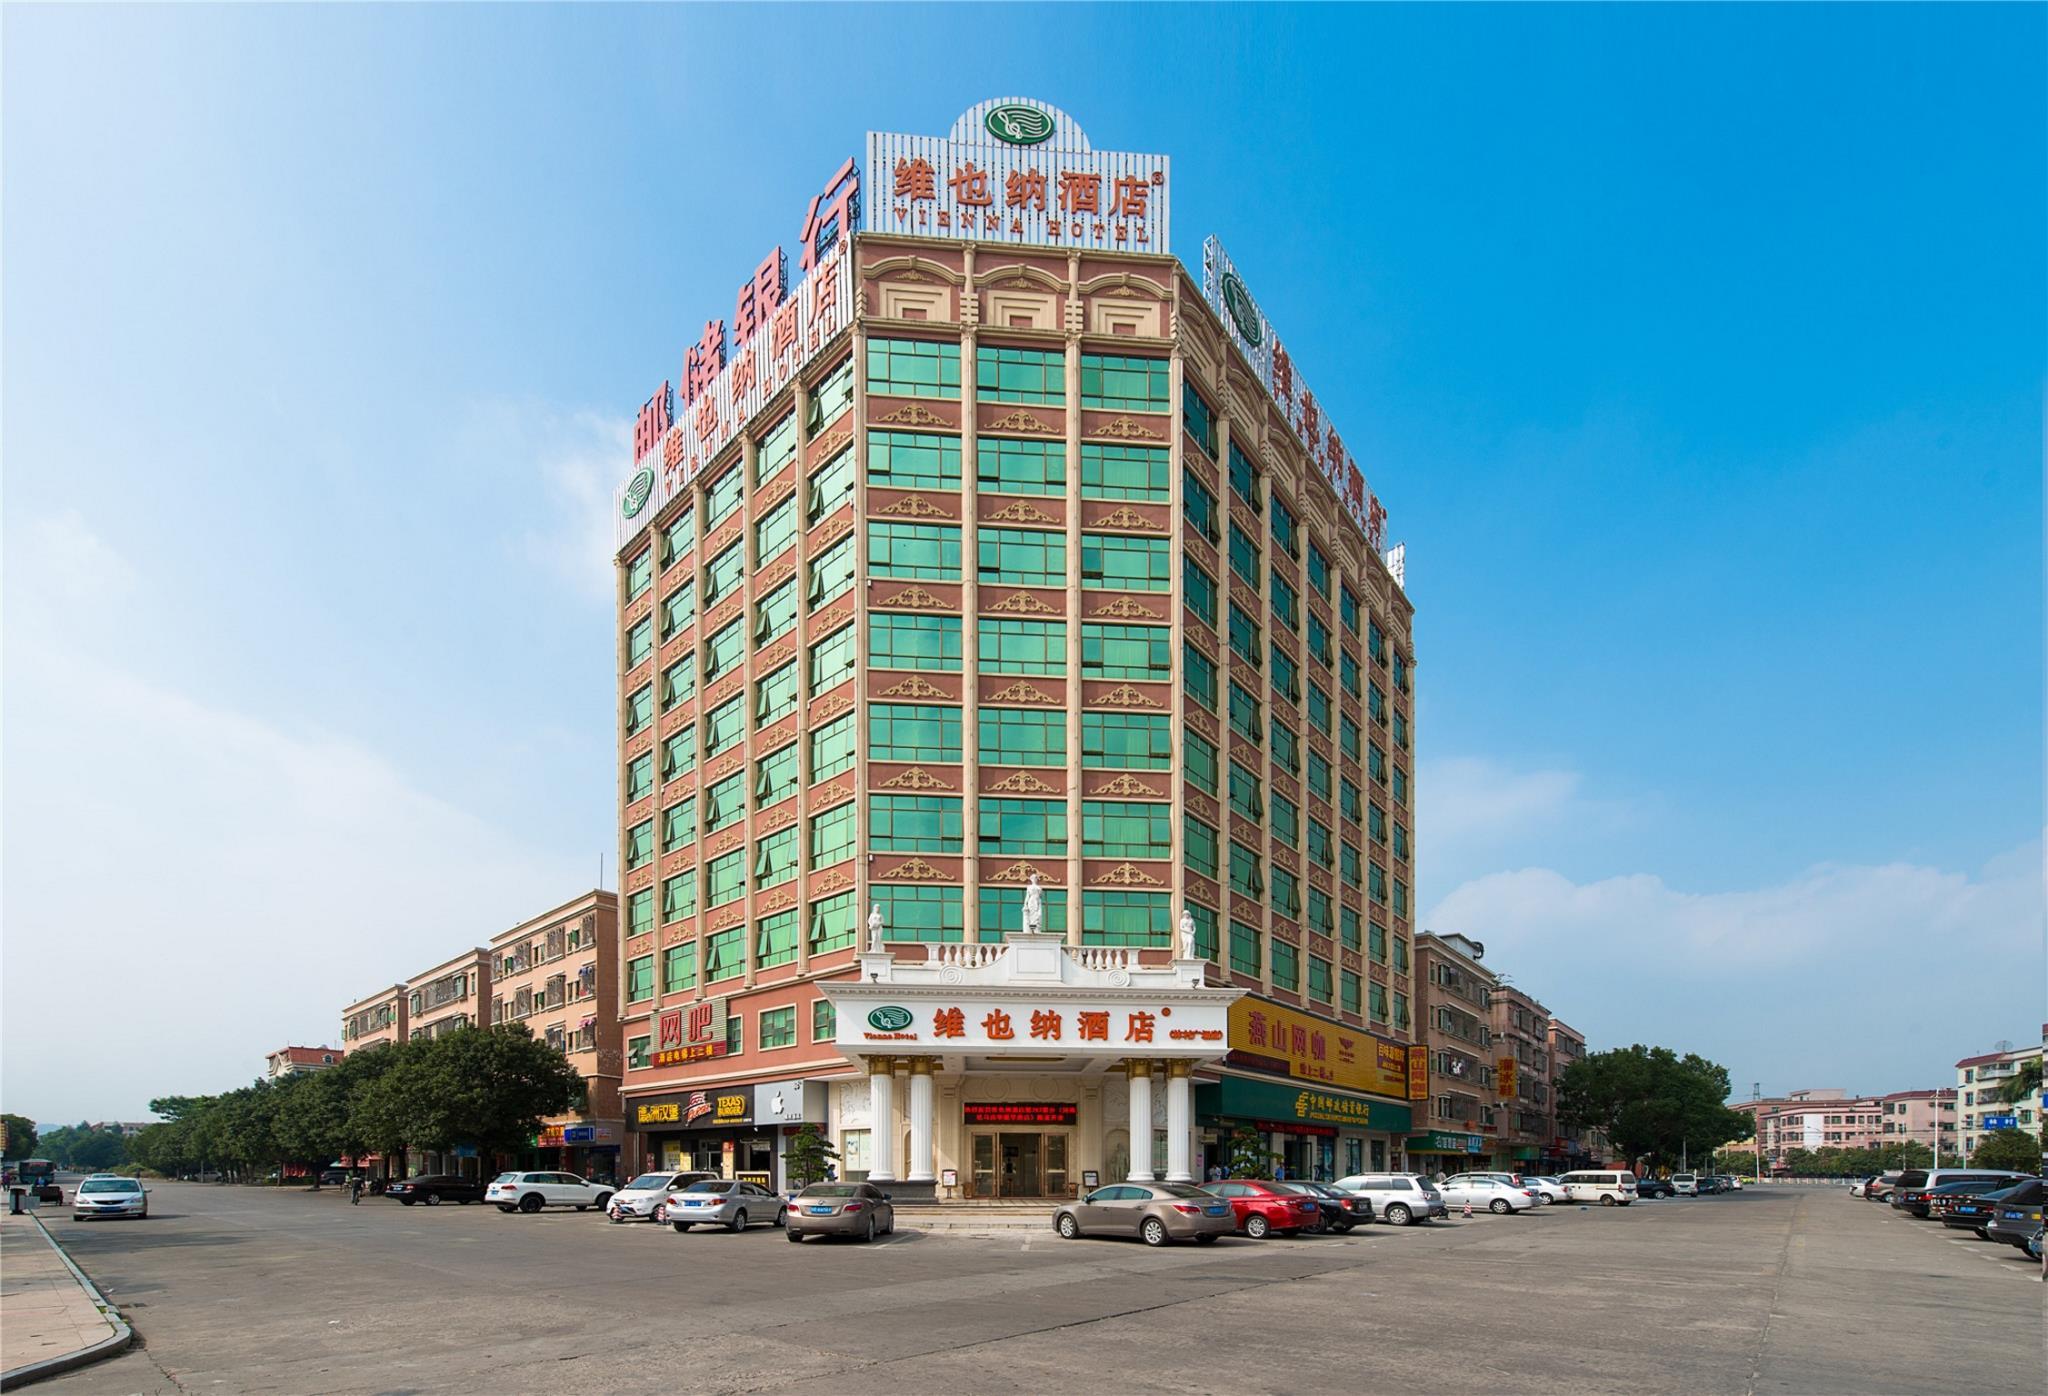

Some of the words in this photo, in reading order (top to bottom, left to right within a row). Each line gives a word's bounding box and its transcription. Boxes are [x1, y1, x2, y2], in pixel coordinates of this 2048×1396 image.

[893, 157, 1150, 219] 维也纳酒店
[892, 206, 1024, 235] VIENNA
[1046, 219, 1150, 244] HOTEL
[663, 257, 838, 475] 维也纳酒店
[659, 1003, 713, 1049] 网吧
[863, 1032, 893, 1041] Vienna
[894, 1032, 918, 1041] Hotel
[932, 1006, 1157, 1043] 维也纳酒店
[1248, 1010, 1327, 1061] 燕山网咖
[717, 1096, 741, 1107] TEXAS
